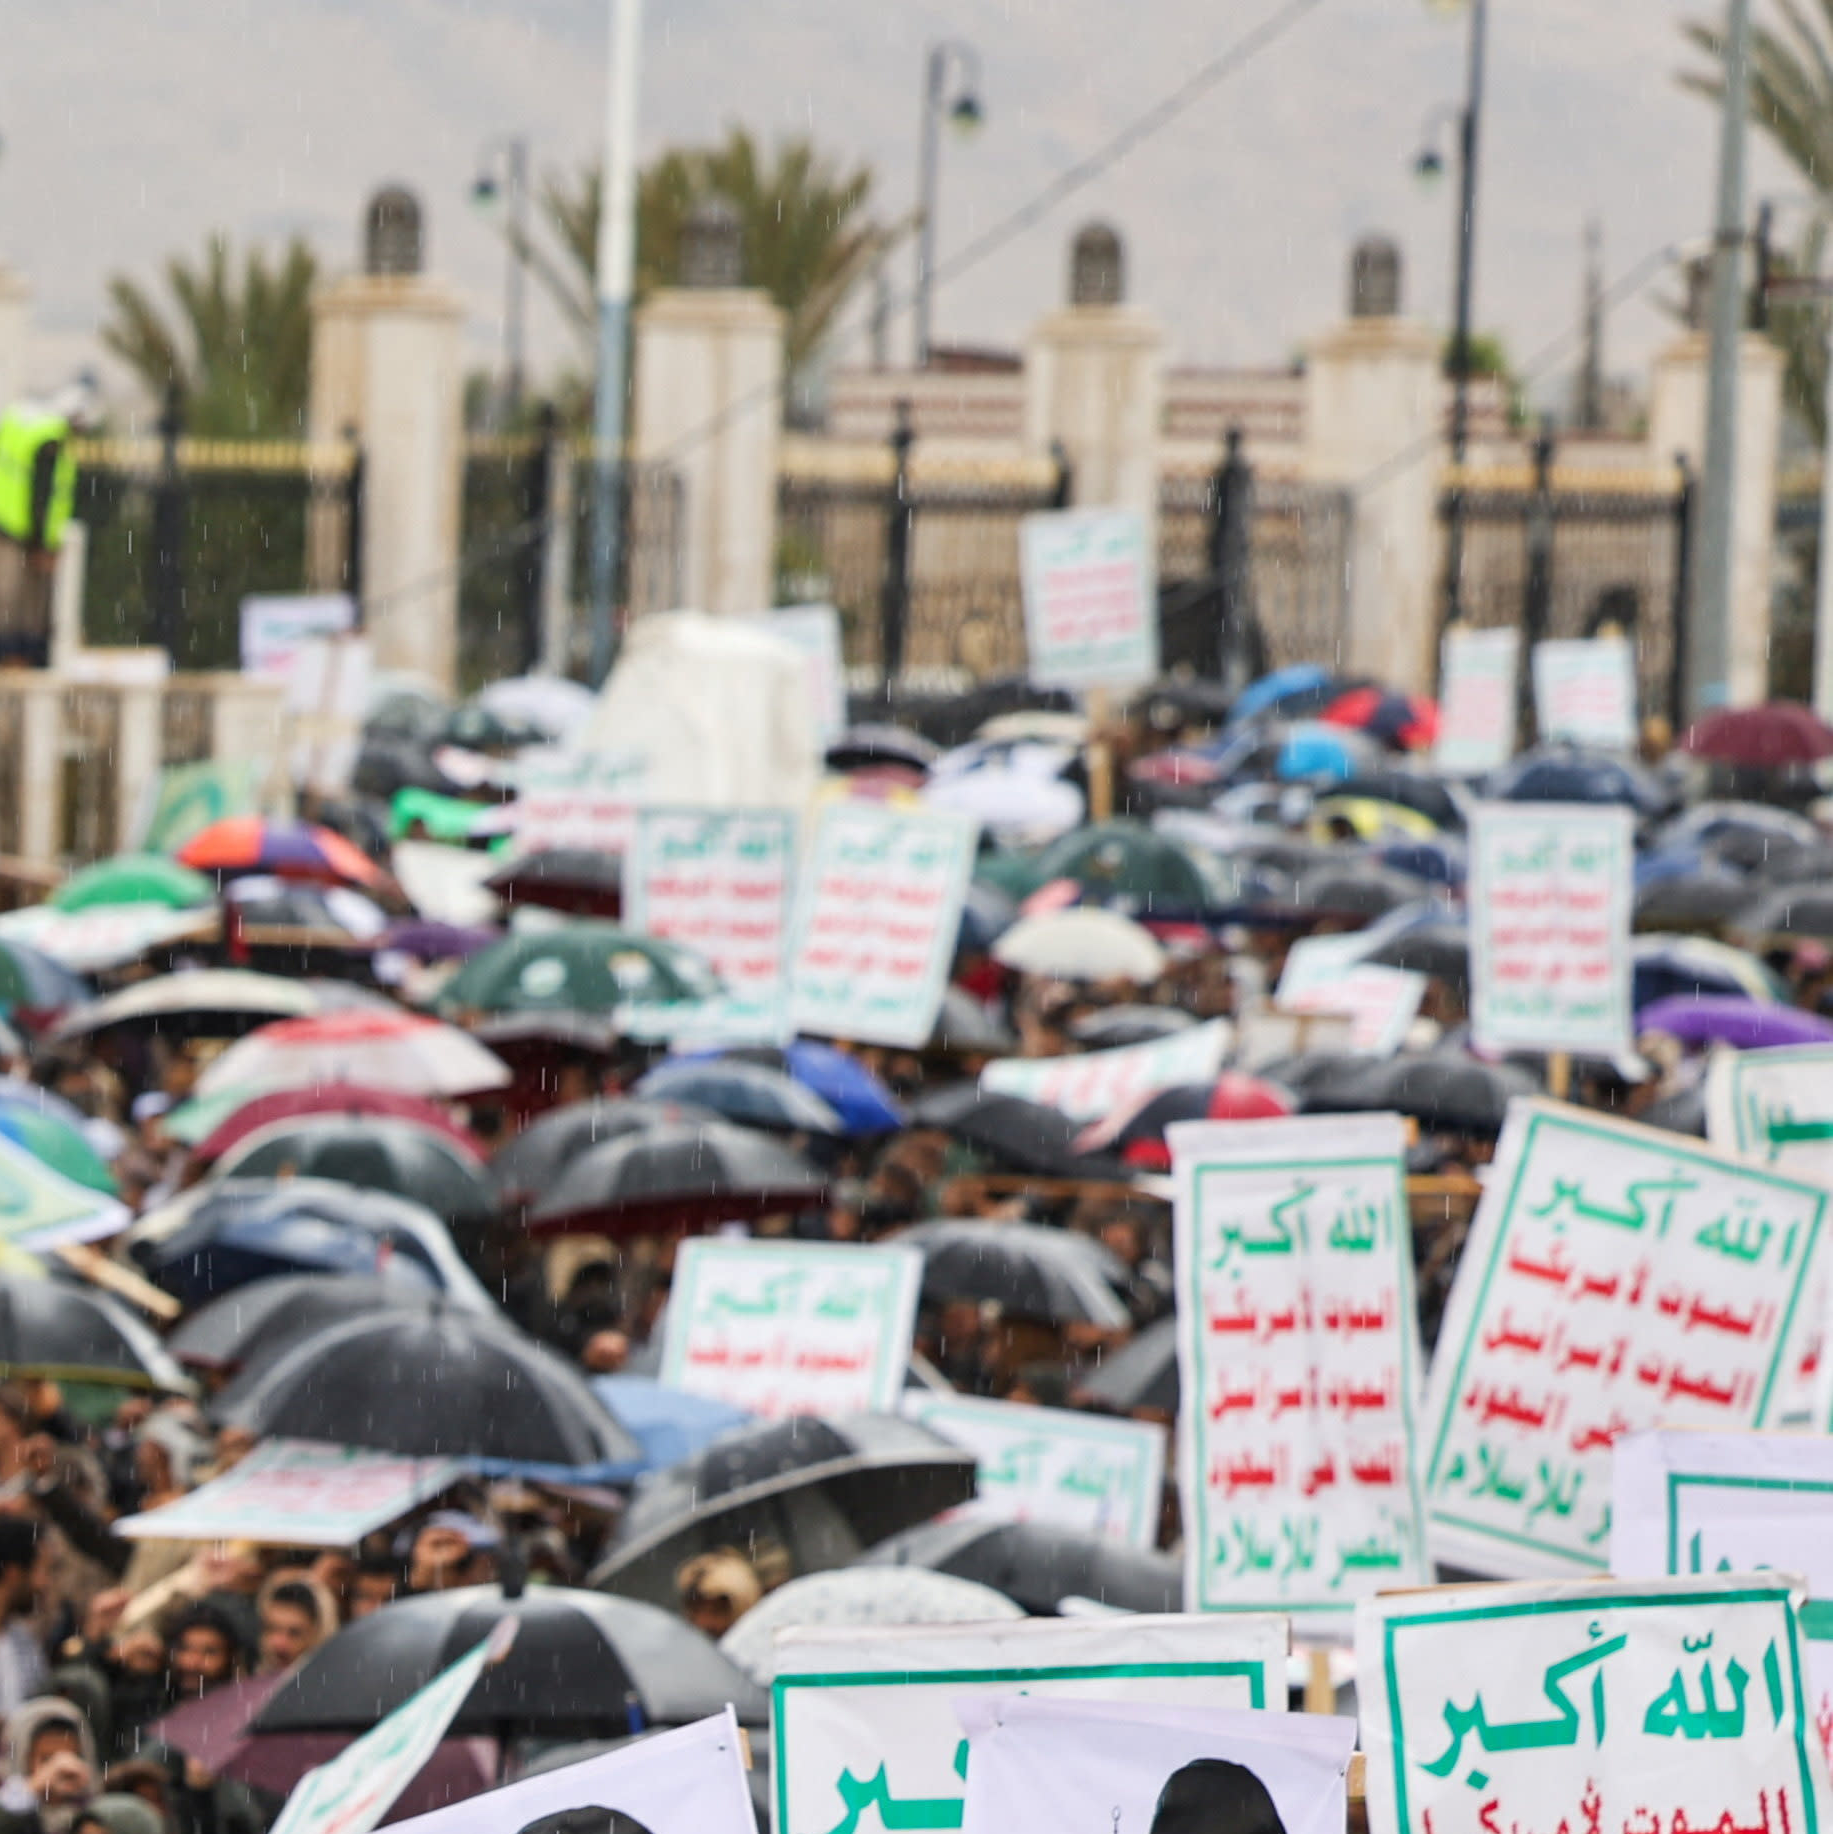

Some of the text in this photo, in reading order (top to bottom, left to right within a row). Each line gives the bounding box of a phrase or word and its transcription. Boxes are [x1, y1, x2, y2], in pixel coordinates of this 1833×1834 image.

[1208, 1184, 1393, 1280] الله أكبر
[1528, 1168, 1800, 1268] الله أكبر
[1319, 1291, 1394, 1340] الموت
[1505, 1237, 1777, 1340] الموت لأمريكا
[1326, 1362, 1401, 1421] الموت
[1480, 1308, 1757, 1410] الموت لإسرائيل
[1443, 1443, 1585, 1527] للإسلام
[1417, 1621, 1785, 1791] الله أكبر
